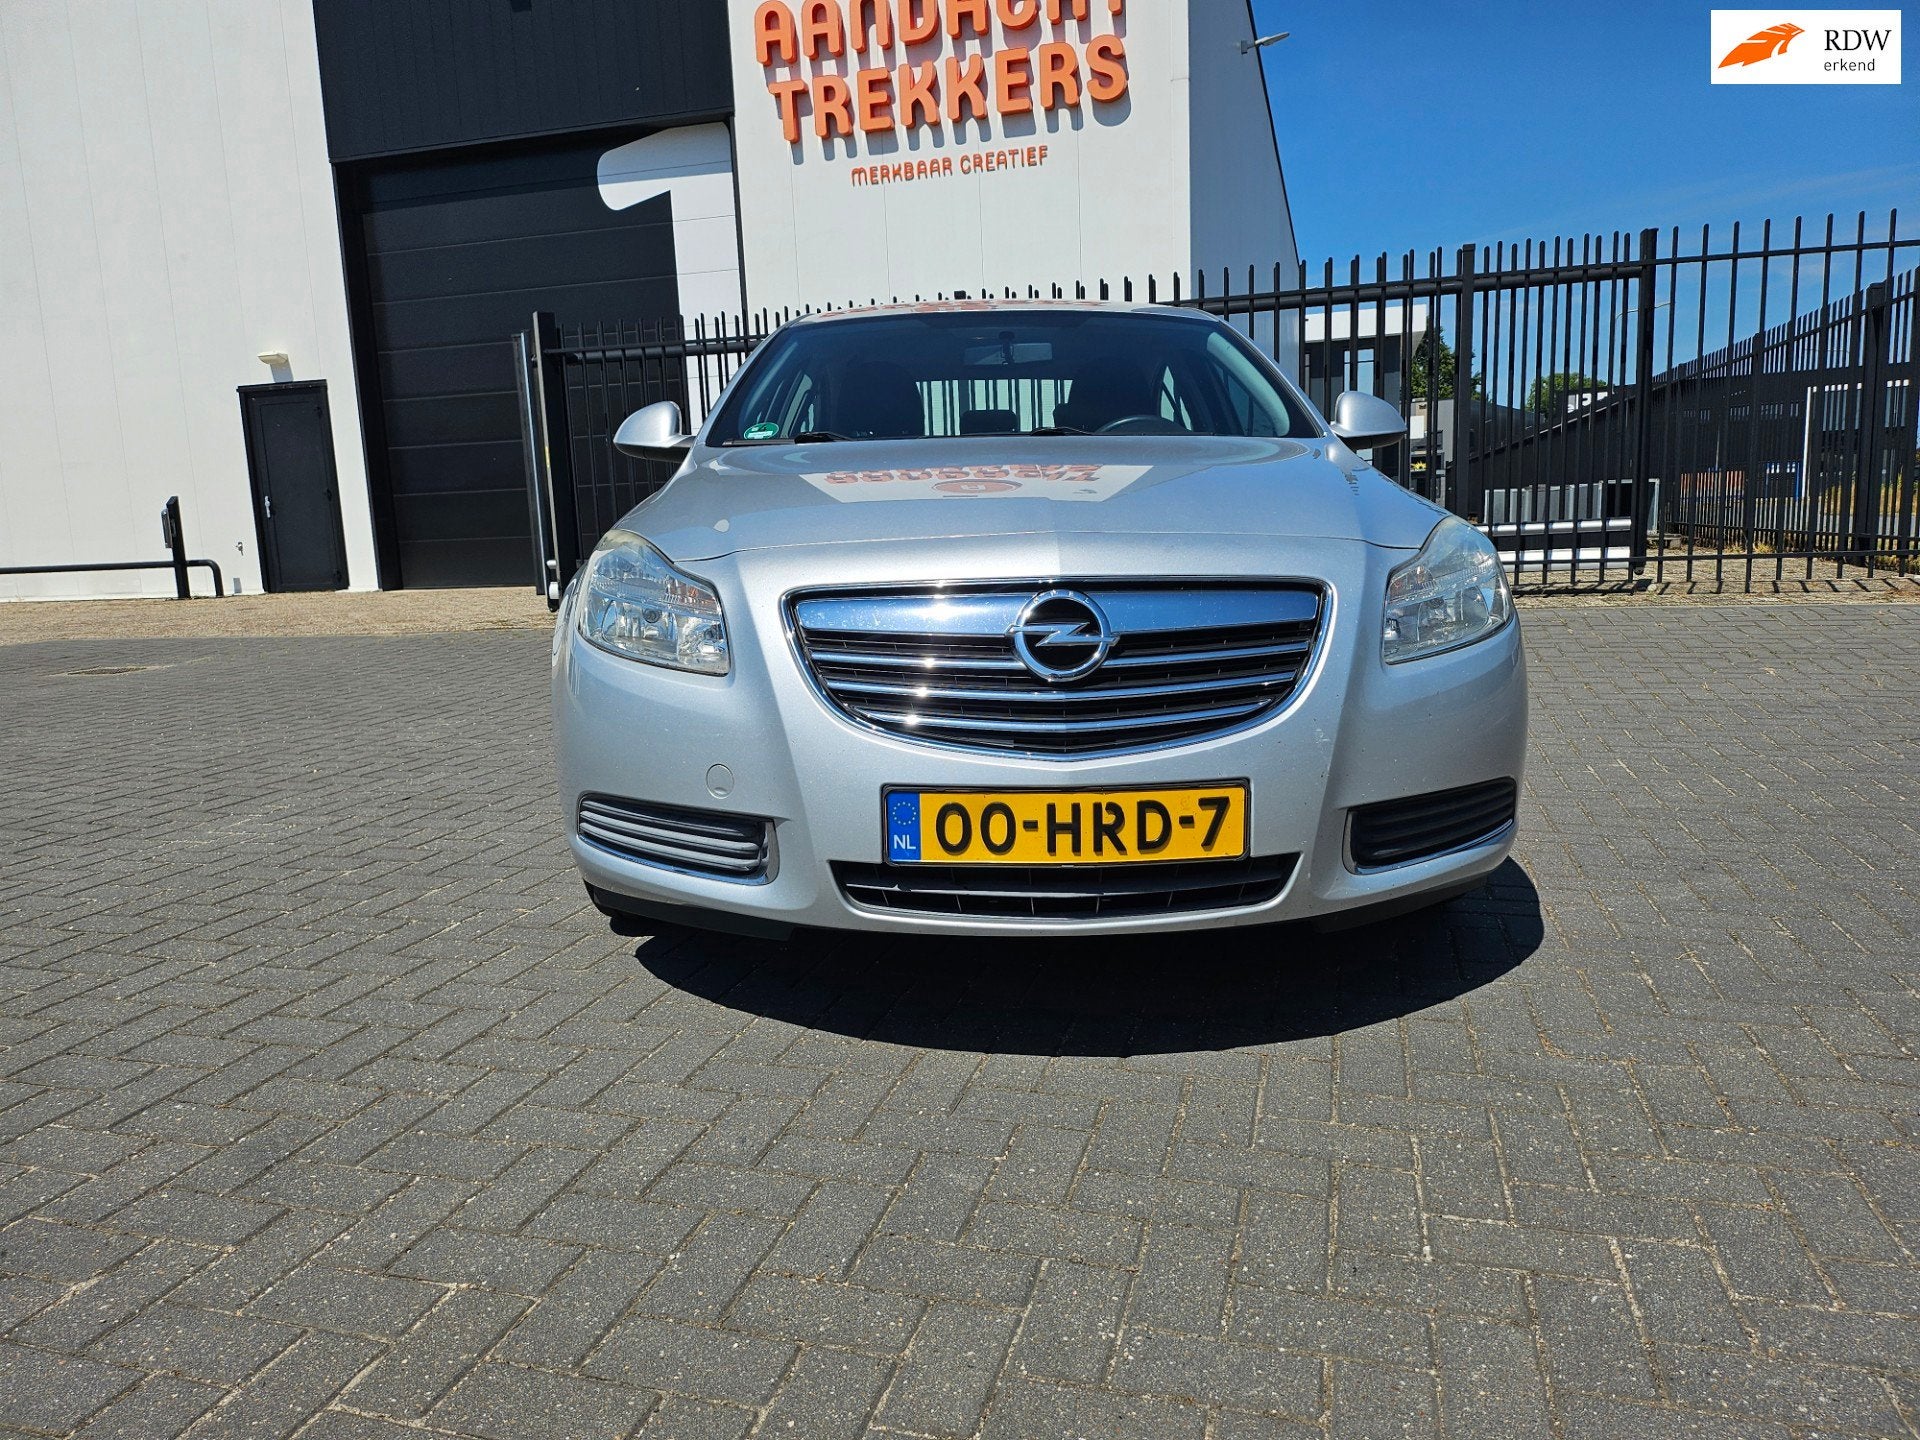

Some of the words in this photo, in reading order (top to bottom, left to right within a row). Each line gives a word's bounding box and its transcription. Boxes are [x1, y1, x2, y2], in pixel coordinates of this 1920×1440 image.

[769, 34, 1129, 143] TREKKERS
[851, 156, 953, 187] MERKBAAR
[960, 145, 1048, 175] CREATIEF
[893, 834, 917, 850] NL
[935, 796, 1231, 857] 00-HRD-7
